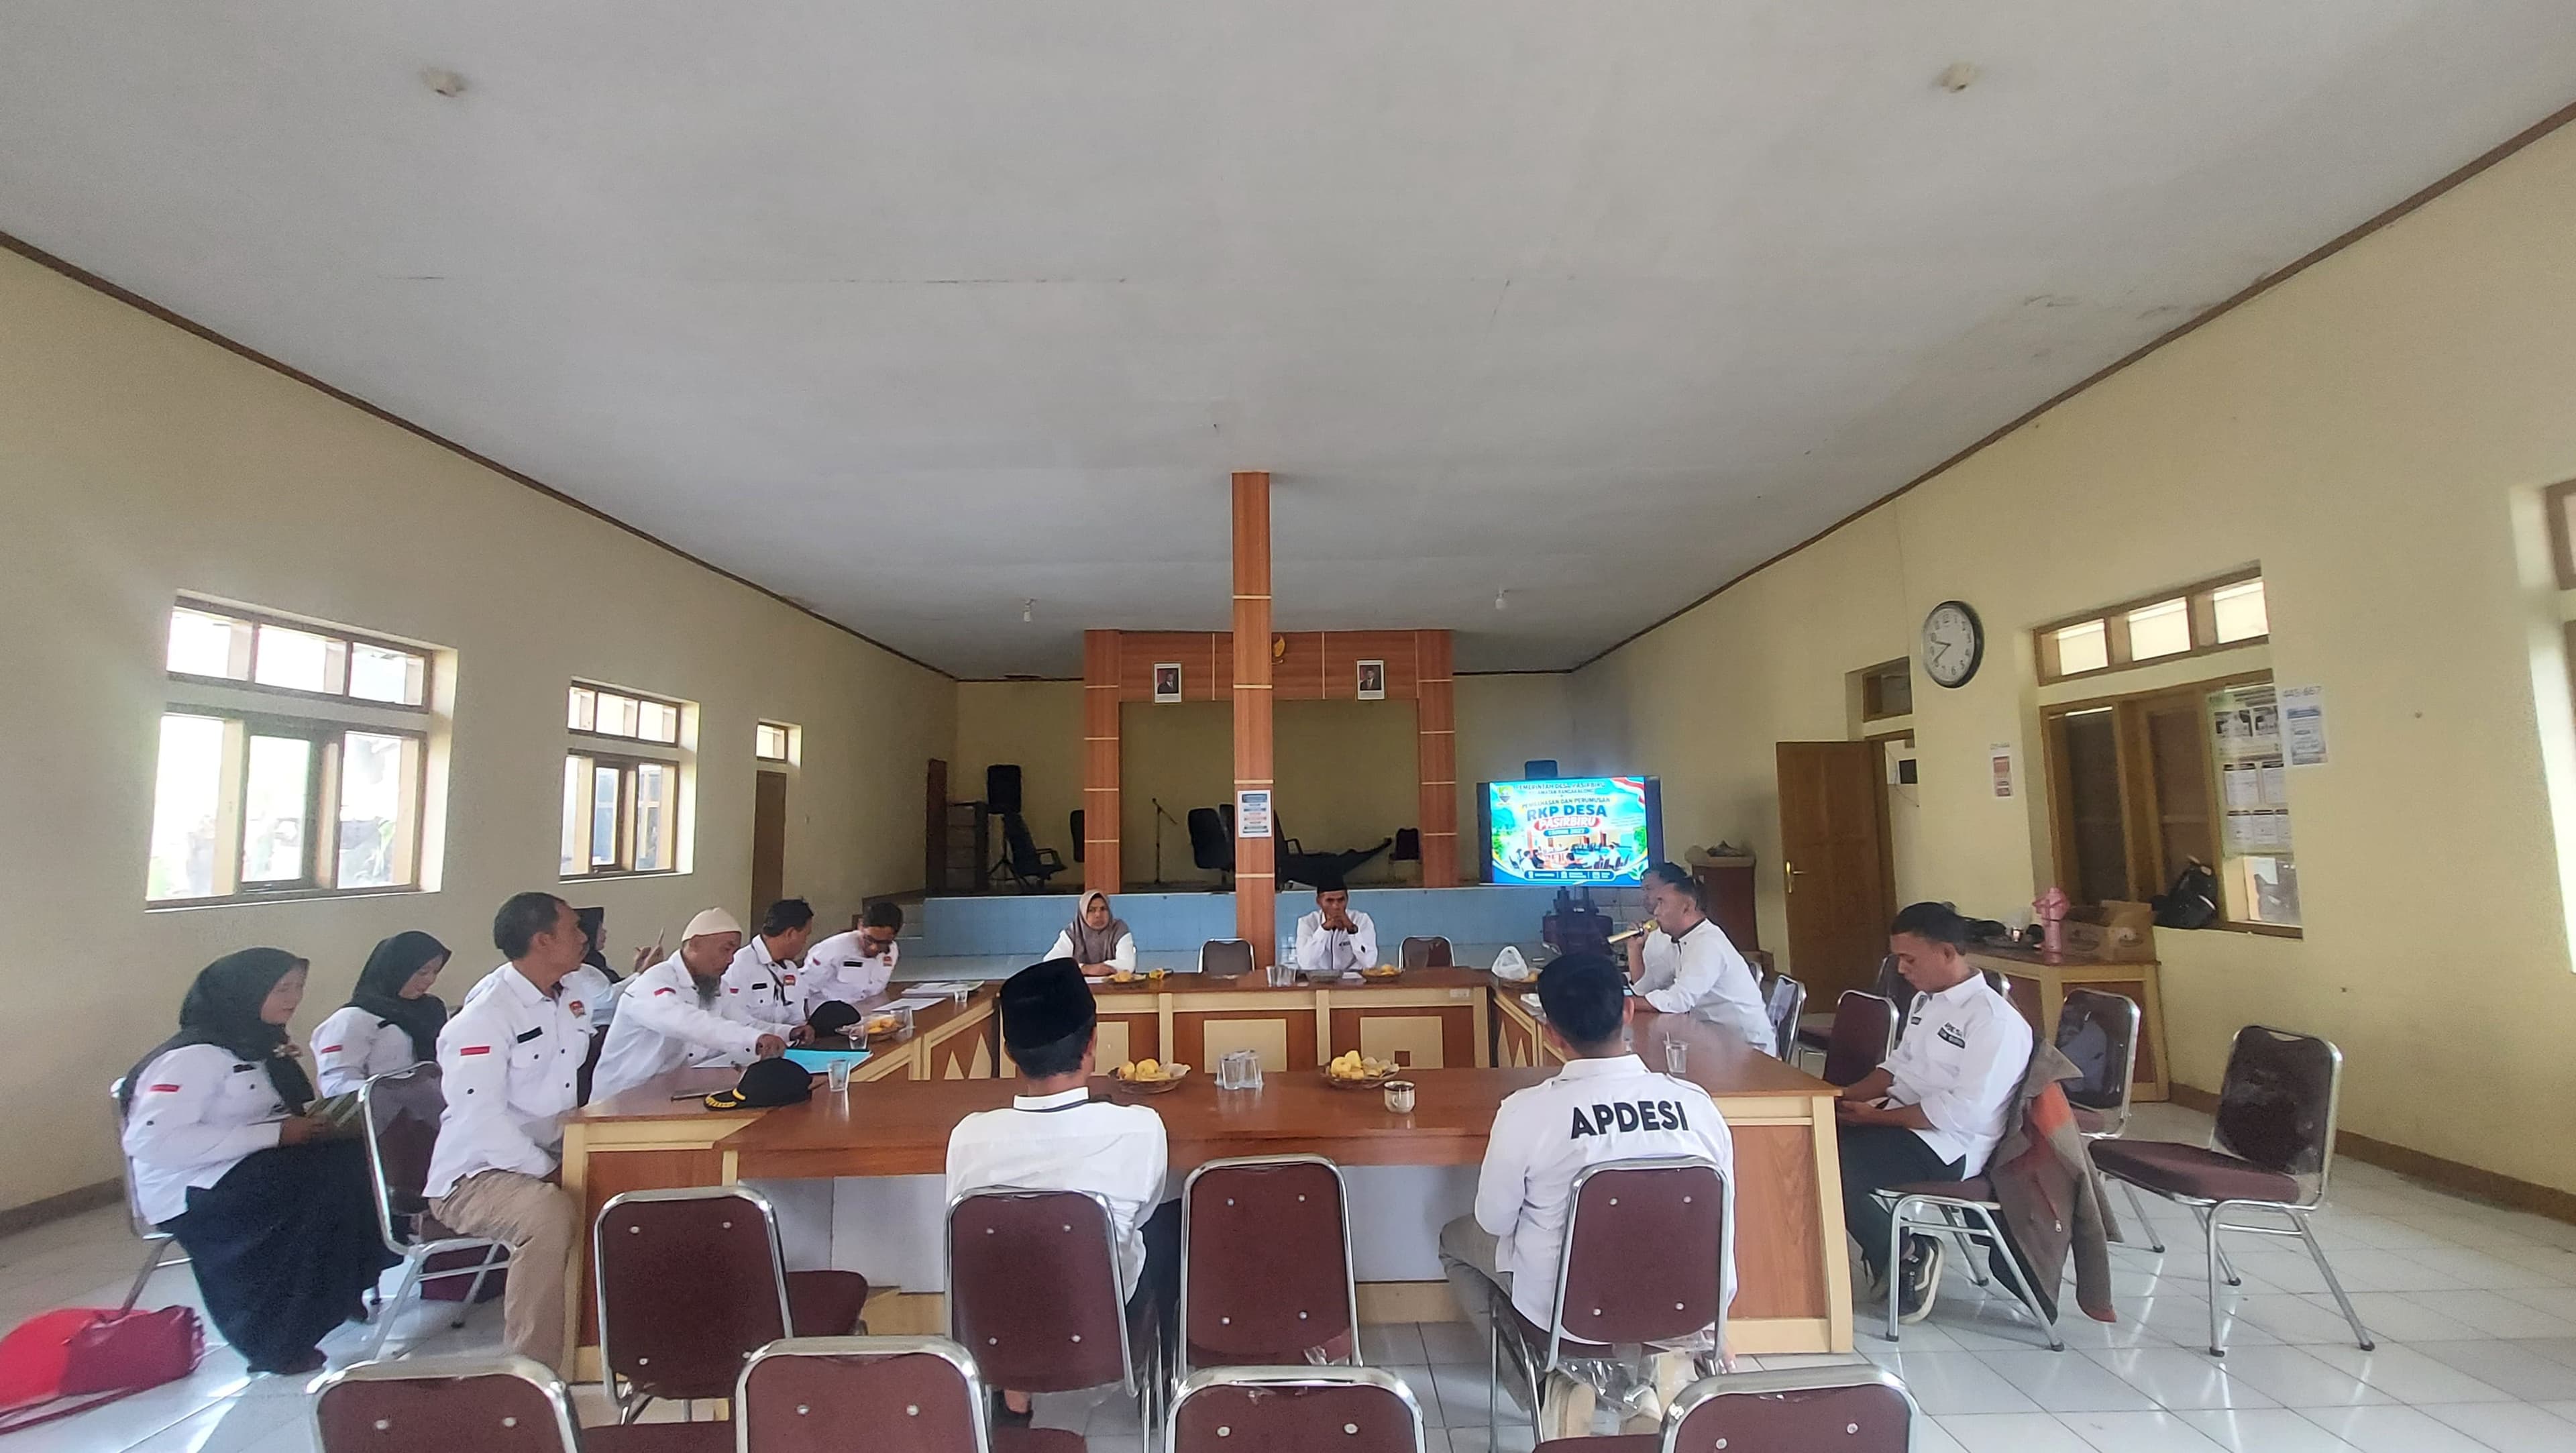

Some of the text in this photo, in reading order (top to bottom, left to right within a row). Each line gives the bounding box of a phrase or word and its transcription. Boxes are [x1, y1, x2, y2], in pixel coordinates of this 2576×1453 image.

[1527, 804, 1608, 822] RKP DESA
[1538, 816, 1596, 829] PASIRBIRU
[1570, 1101, 1690, 1140] APDESI
